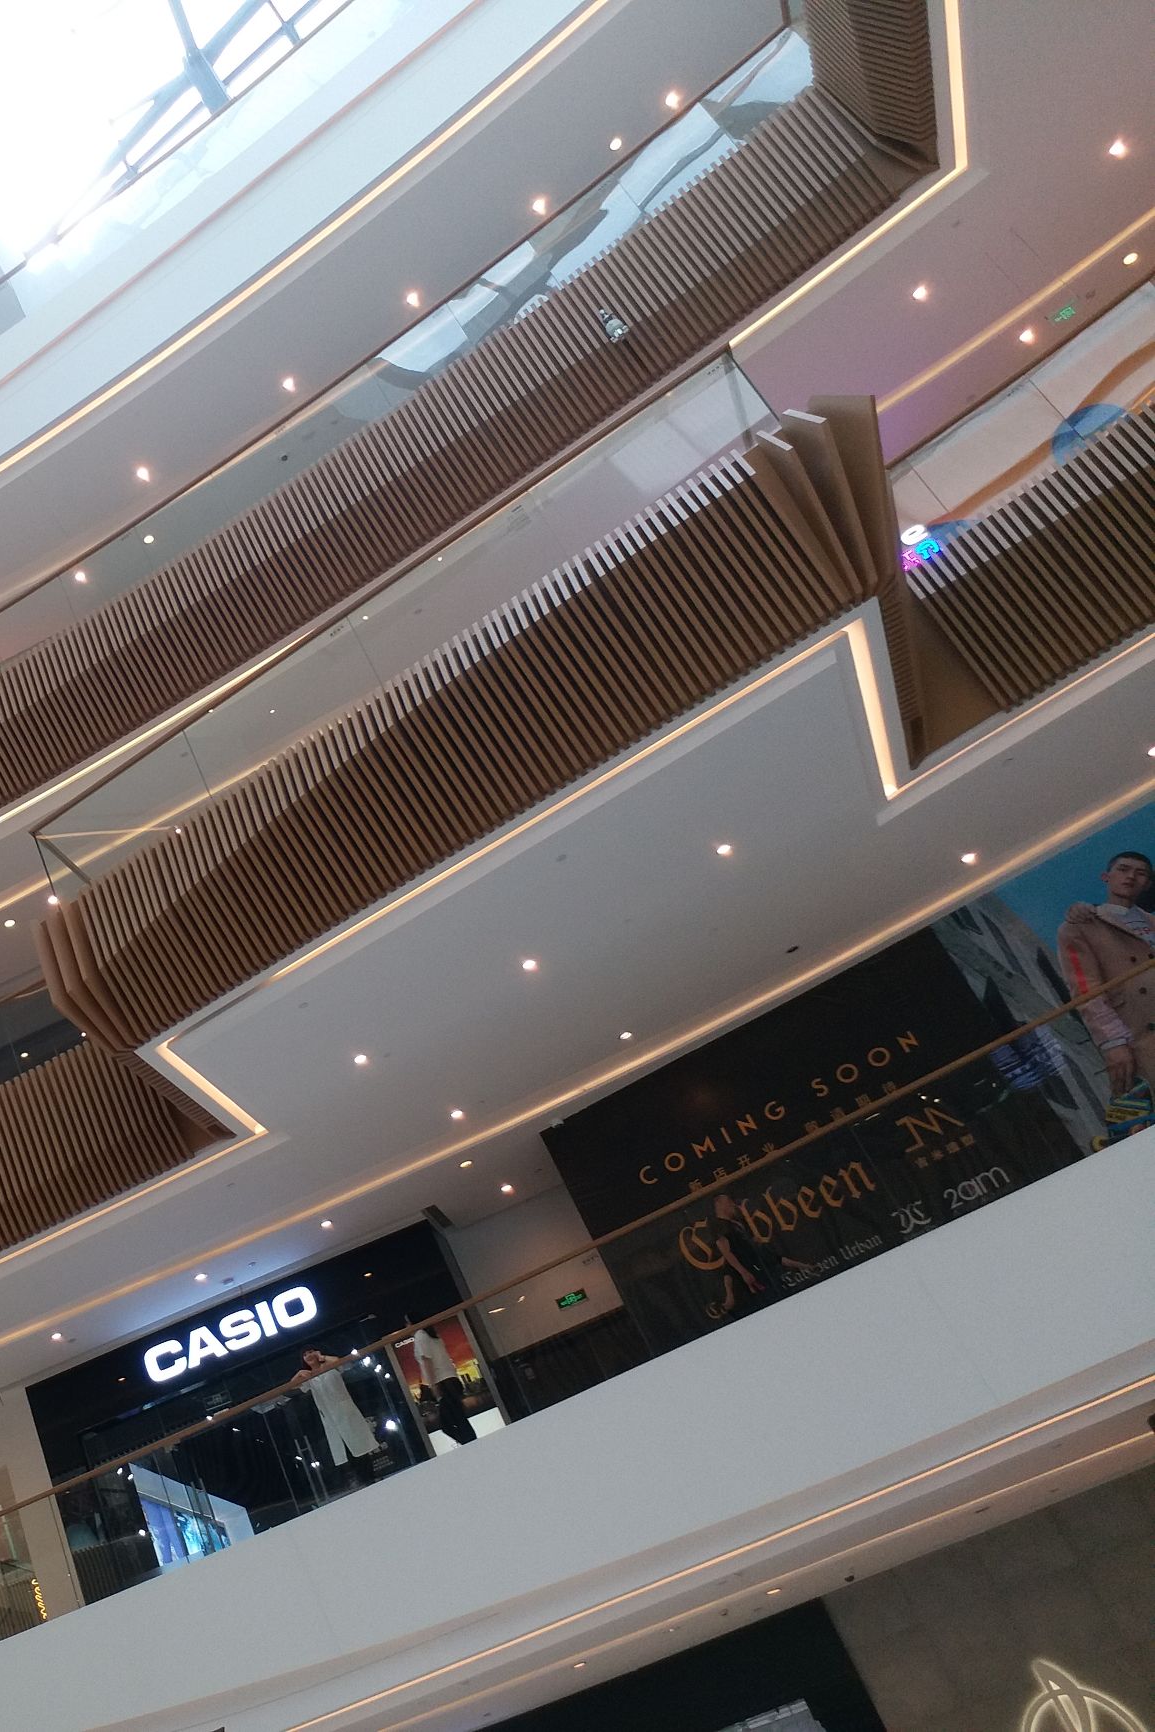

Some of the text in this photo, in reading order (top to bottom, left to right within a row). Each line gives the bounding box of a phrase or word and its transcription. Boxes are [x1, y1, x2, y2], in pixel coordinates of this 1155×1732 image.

[639, 1031, 919, 1185] COMING SOON
[678, 1161, 876, 1271] Cbbeen
[143, 1286, 318, 1383] CASIO
